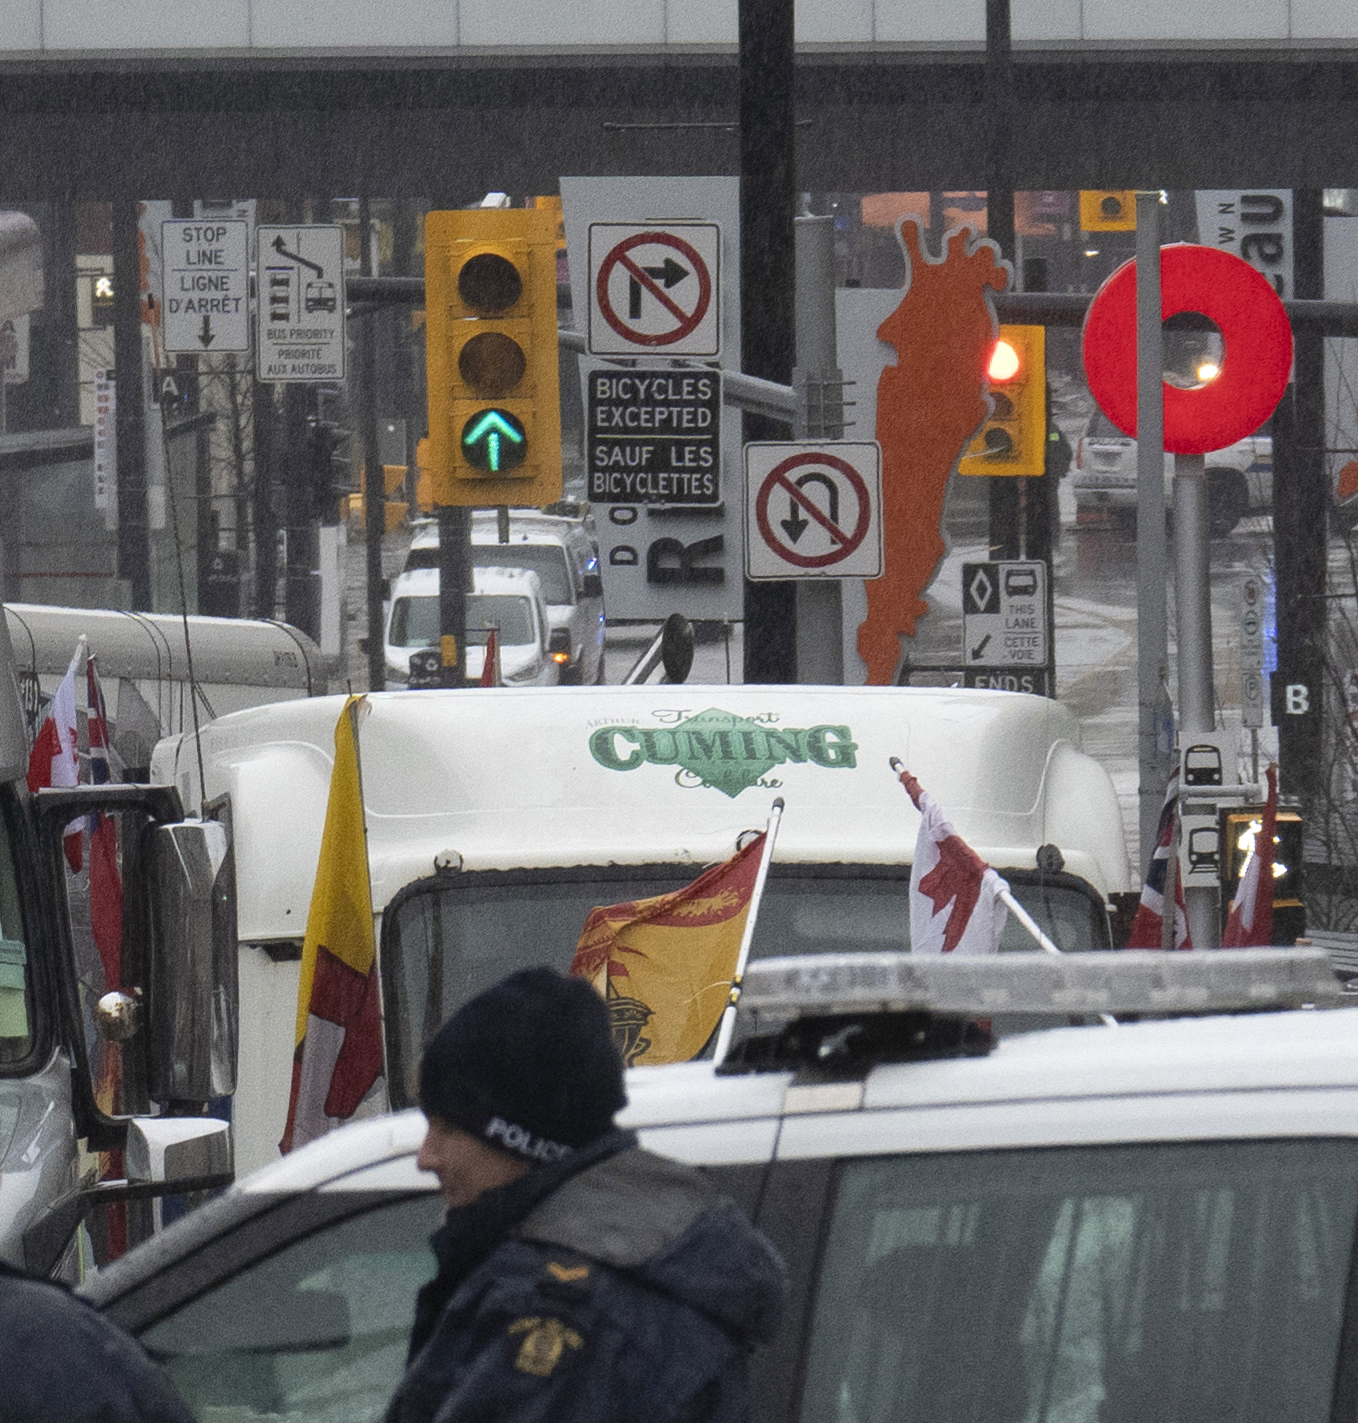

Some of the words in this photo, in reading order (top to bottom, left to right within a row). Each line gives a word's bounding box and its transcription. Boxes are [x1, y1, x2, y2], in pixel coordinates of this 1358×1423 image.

[183, 227, 227, 243] STOP
[186, 249, 225, 266] LINE
[180, 276, 230, 292] LIGNE
[267, 328, 286, 340] BUS
[290, 328, 335, 340] PRIORITY
[267, 364, 287, 375] AUX
[290, 364, 338, 375] AUTOBUS
[162, 376, 179, 396] A
[596, 378, 712, 400] BICYCLES
[596, 406, 712, 429] EXCEPTED
[595, 446, 654, 467] SAUF
[671, 446, 714, 467] LES
[593, 472, 714, 495] BICYCLETTES
[1009, 604, 1035, 615] THIS
[1005, 618, 1037, 629] LANE
[1004, 636, 1039, 648] CETTE
[1011, 649, 1035, 660] VOIE
[975, 675, 1034, 694] ENDS
[1286, 684, 1310, 715] B
[588, 724, 859, 772] CUMING
